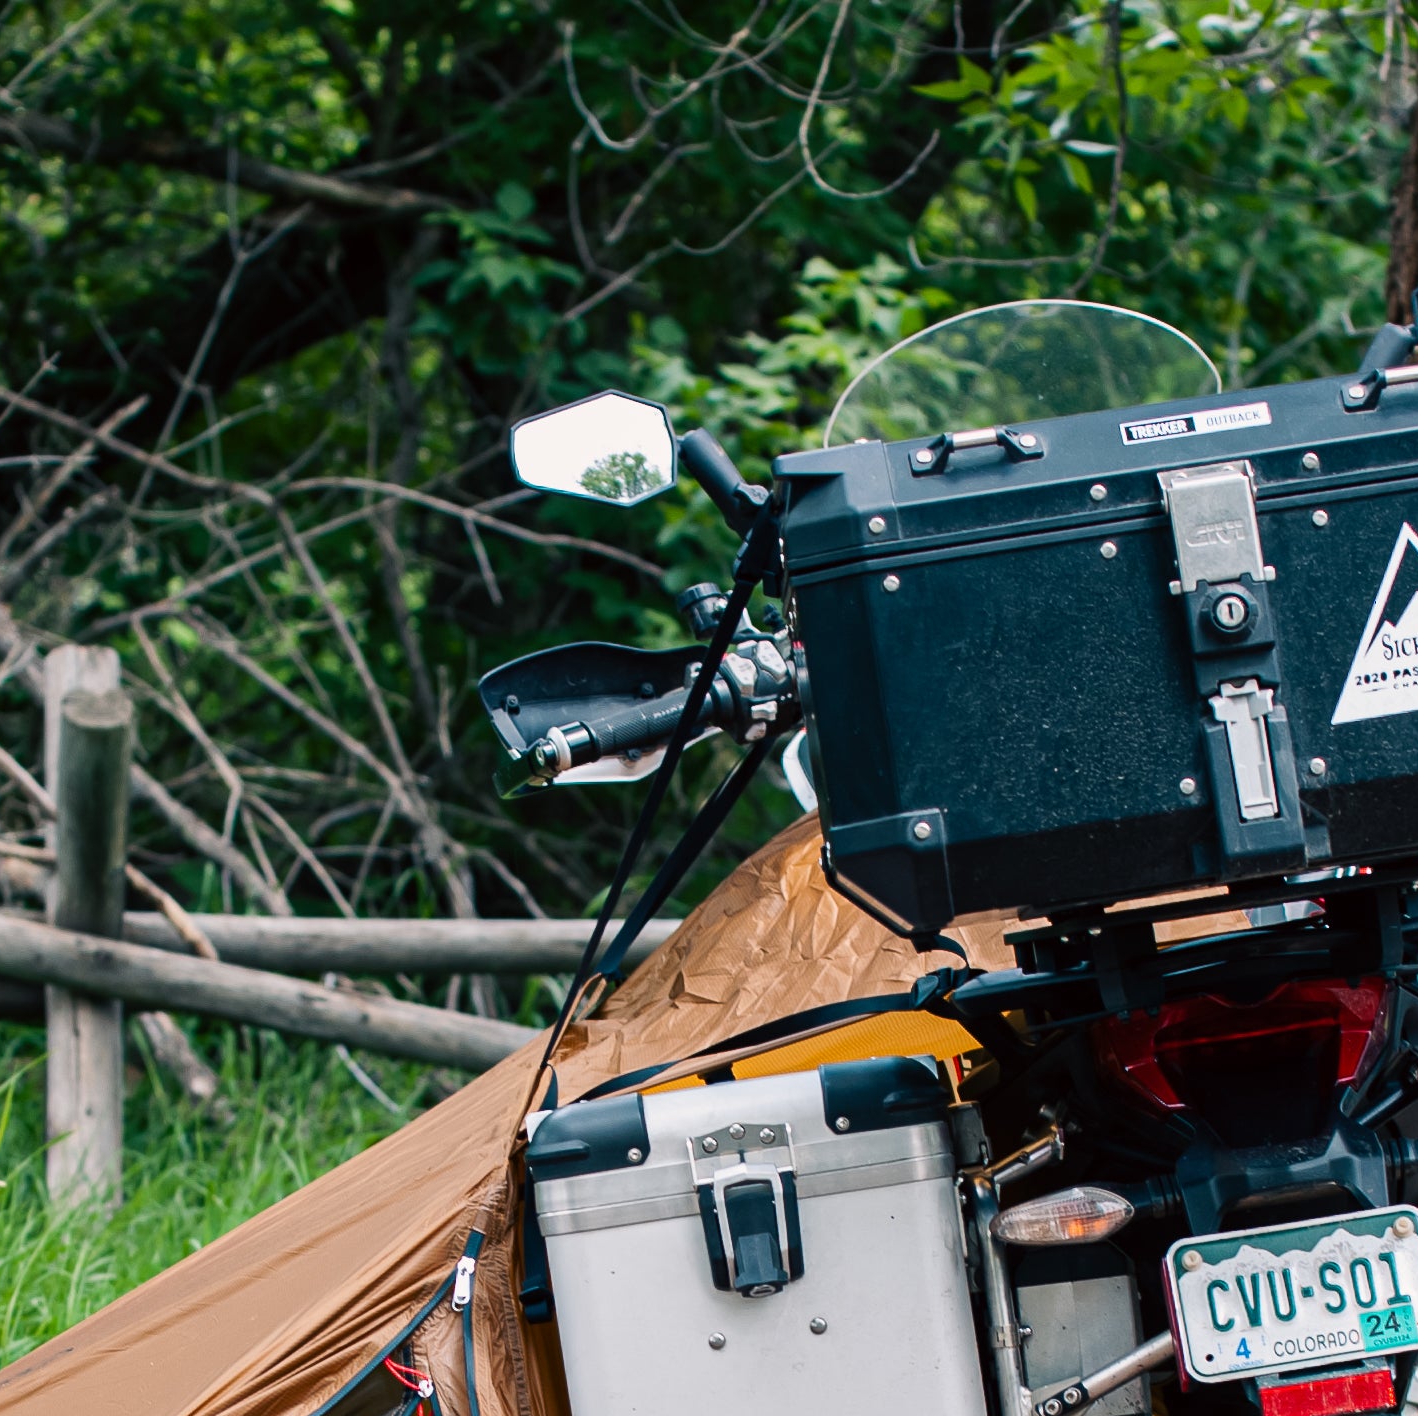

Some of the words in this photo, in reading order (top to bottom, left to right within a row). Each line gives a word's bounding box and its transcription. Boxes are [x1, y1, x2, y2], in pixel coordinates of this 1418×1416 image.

[1129, 419, 1187, 440] TREKKER
[1206, 410, 1261, 427] OUTBACK
[1185, 520, 1245, 548] GIVI
[1355, 671, 1388, 686] 2020
[1366, 1311, 1401, 1337] 24
[1236, 1337, 1251, 1359] 4
[1273, 1329, 1360, 1358] COLORADO
